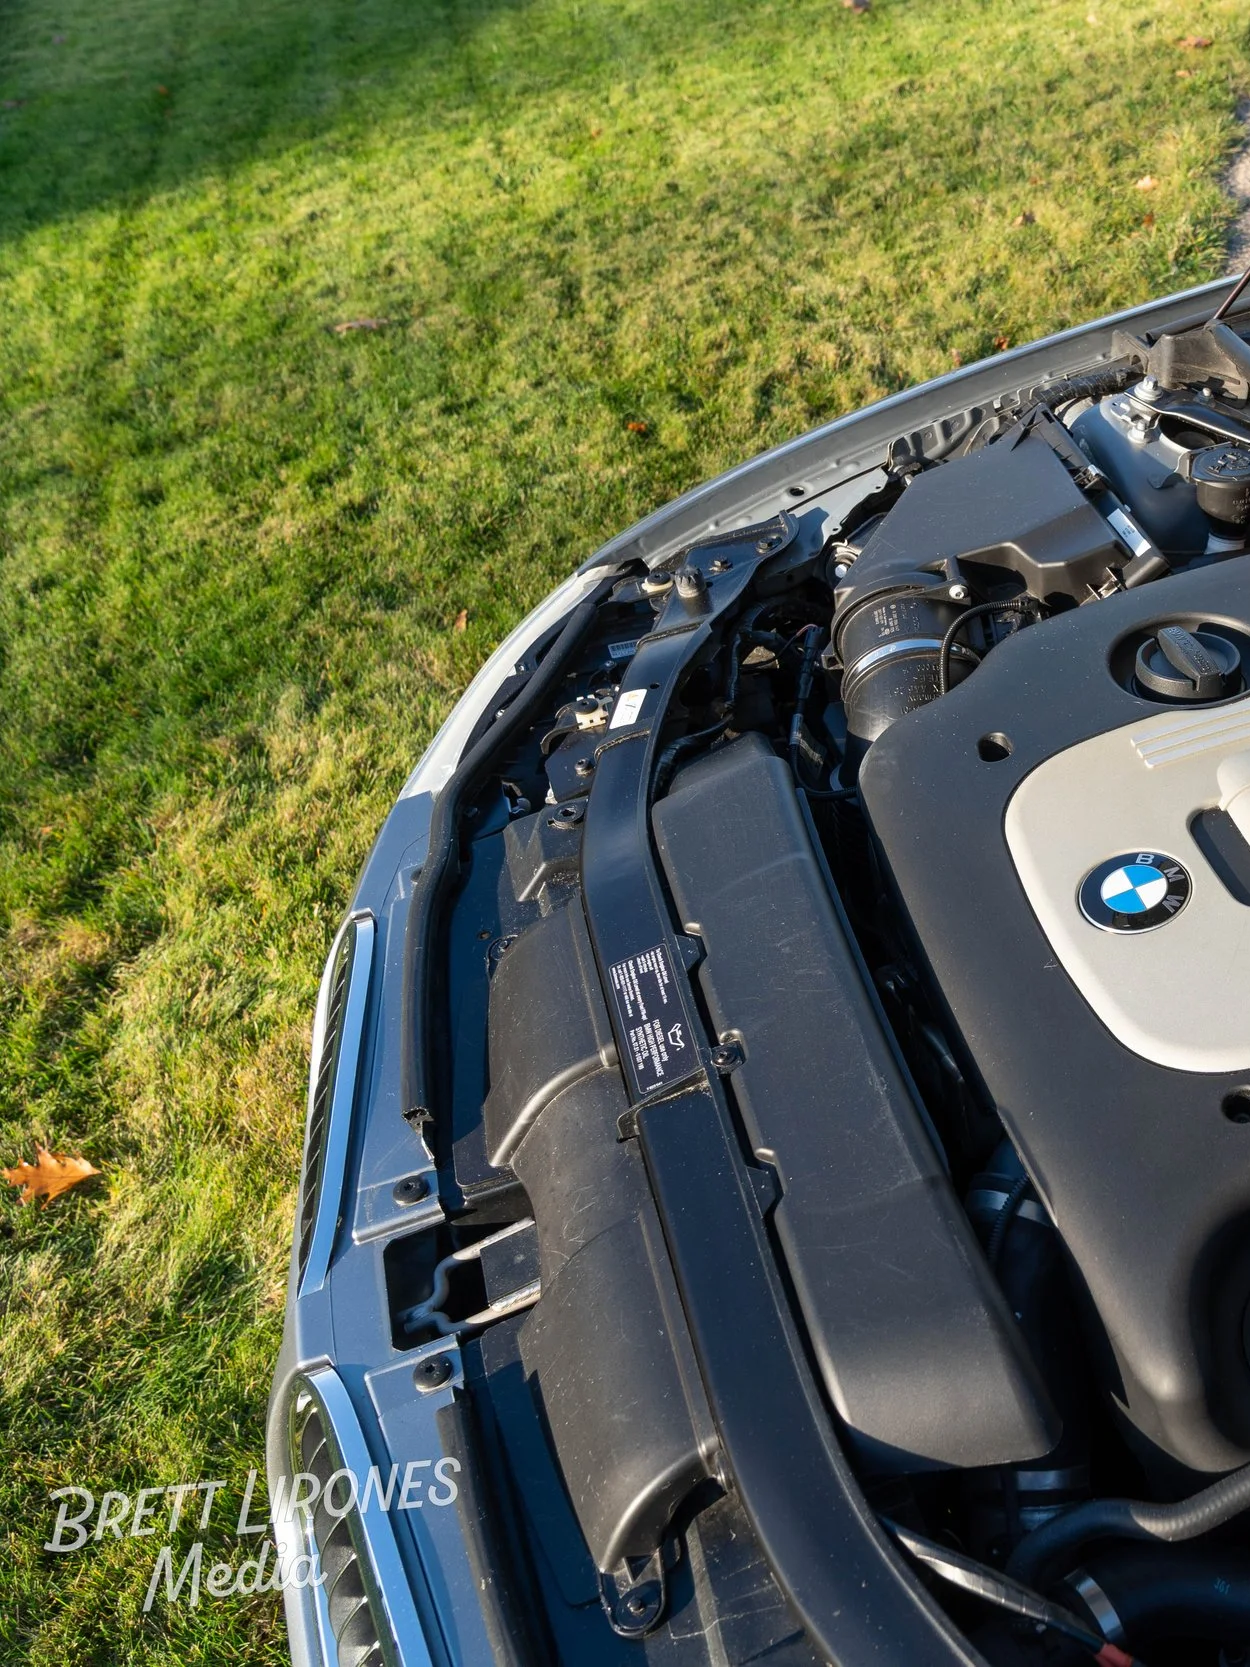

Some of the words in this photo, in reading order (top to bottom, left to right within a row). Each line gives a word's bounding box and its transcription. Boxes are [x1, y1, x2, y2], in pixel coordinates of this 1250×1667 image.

[1135, 853, 1185, 914] BMW
[652, 1019, 661, 1029] FOR
[654, 1028, 664, 1045] DIESEL
